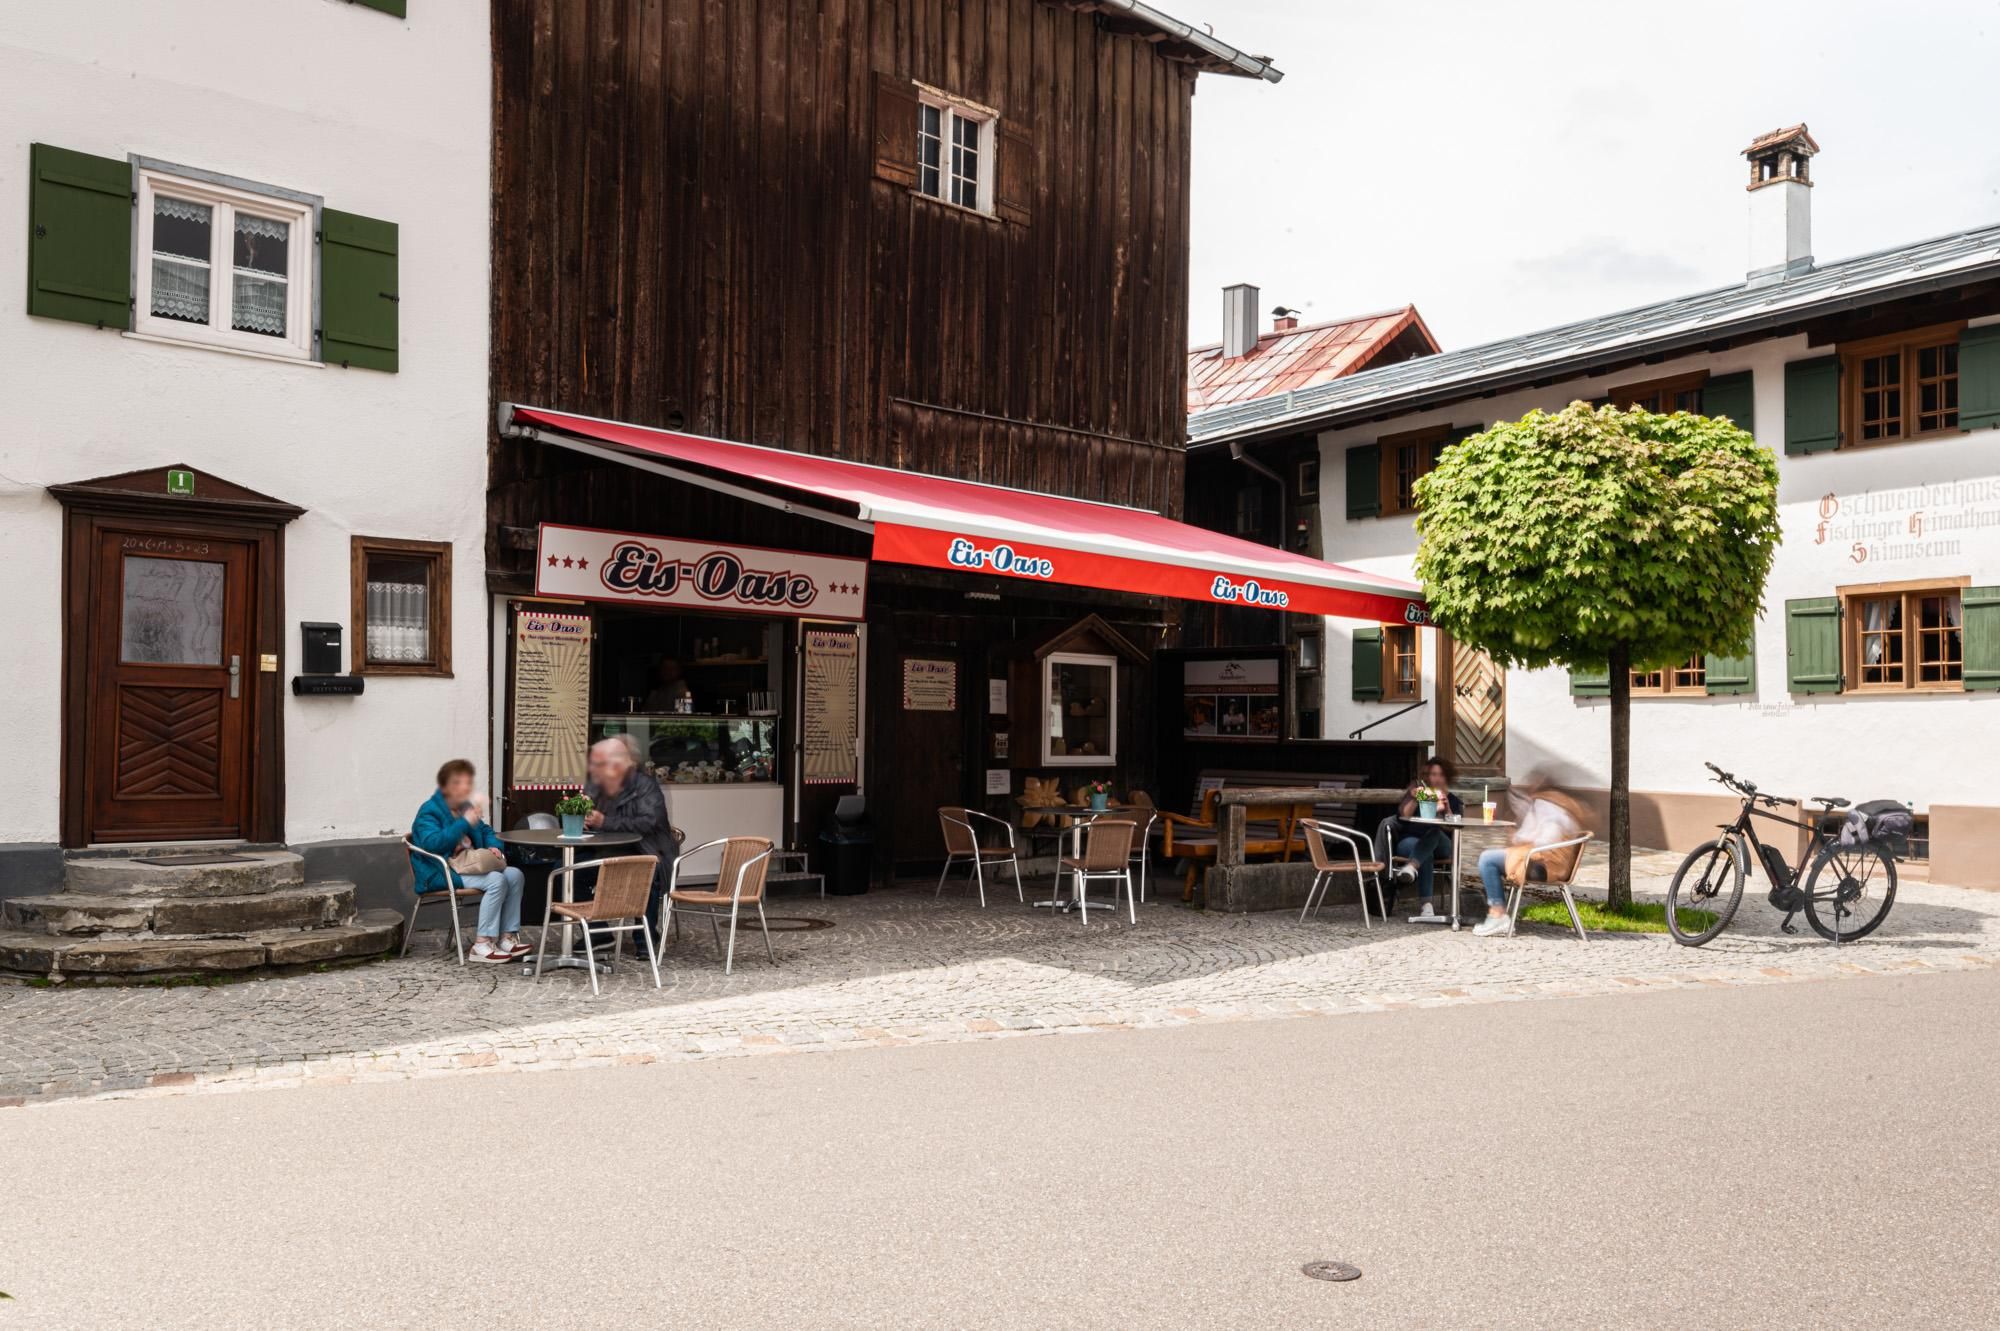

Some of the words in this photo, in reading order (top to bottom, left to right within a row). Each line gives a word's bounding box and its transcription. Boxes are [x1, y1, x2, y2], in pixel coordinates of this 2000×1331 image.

[178, 473, 185, 487] 1
[949, 539, 1053, 576] Eis-Oase
[1849, 539, 1961, 564] Skimuseum
[603, 544, 815, 606] Eis-Oase
[1212, 576, 1288, 606] Eis-Oase
[1405, 602, 1435, 625] Eis-
